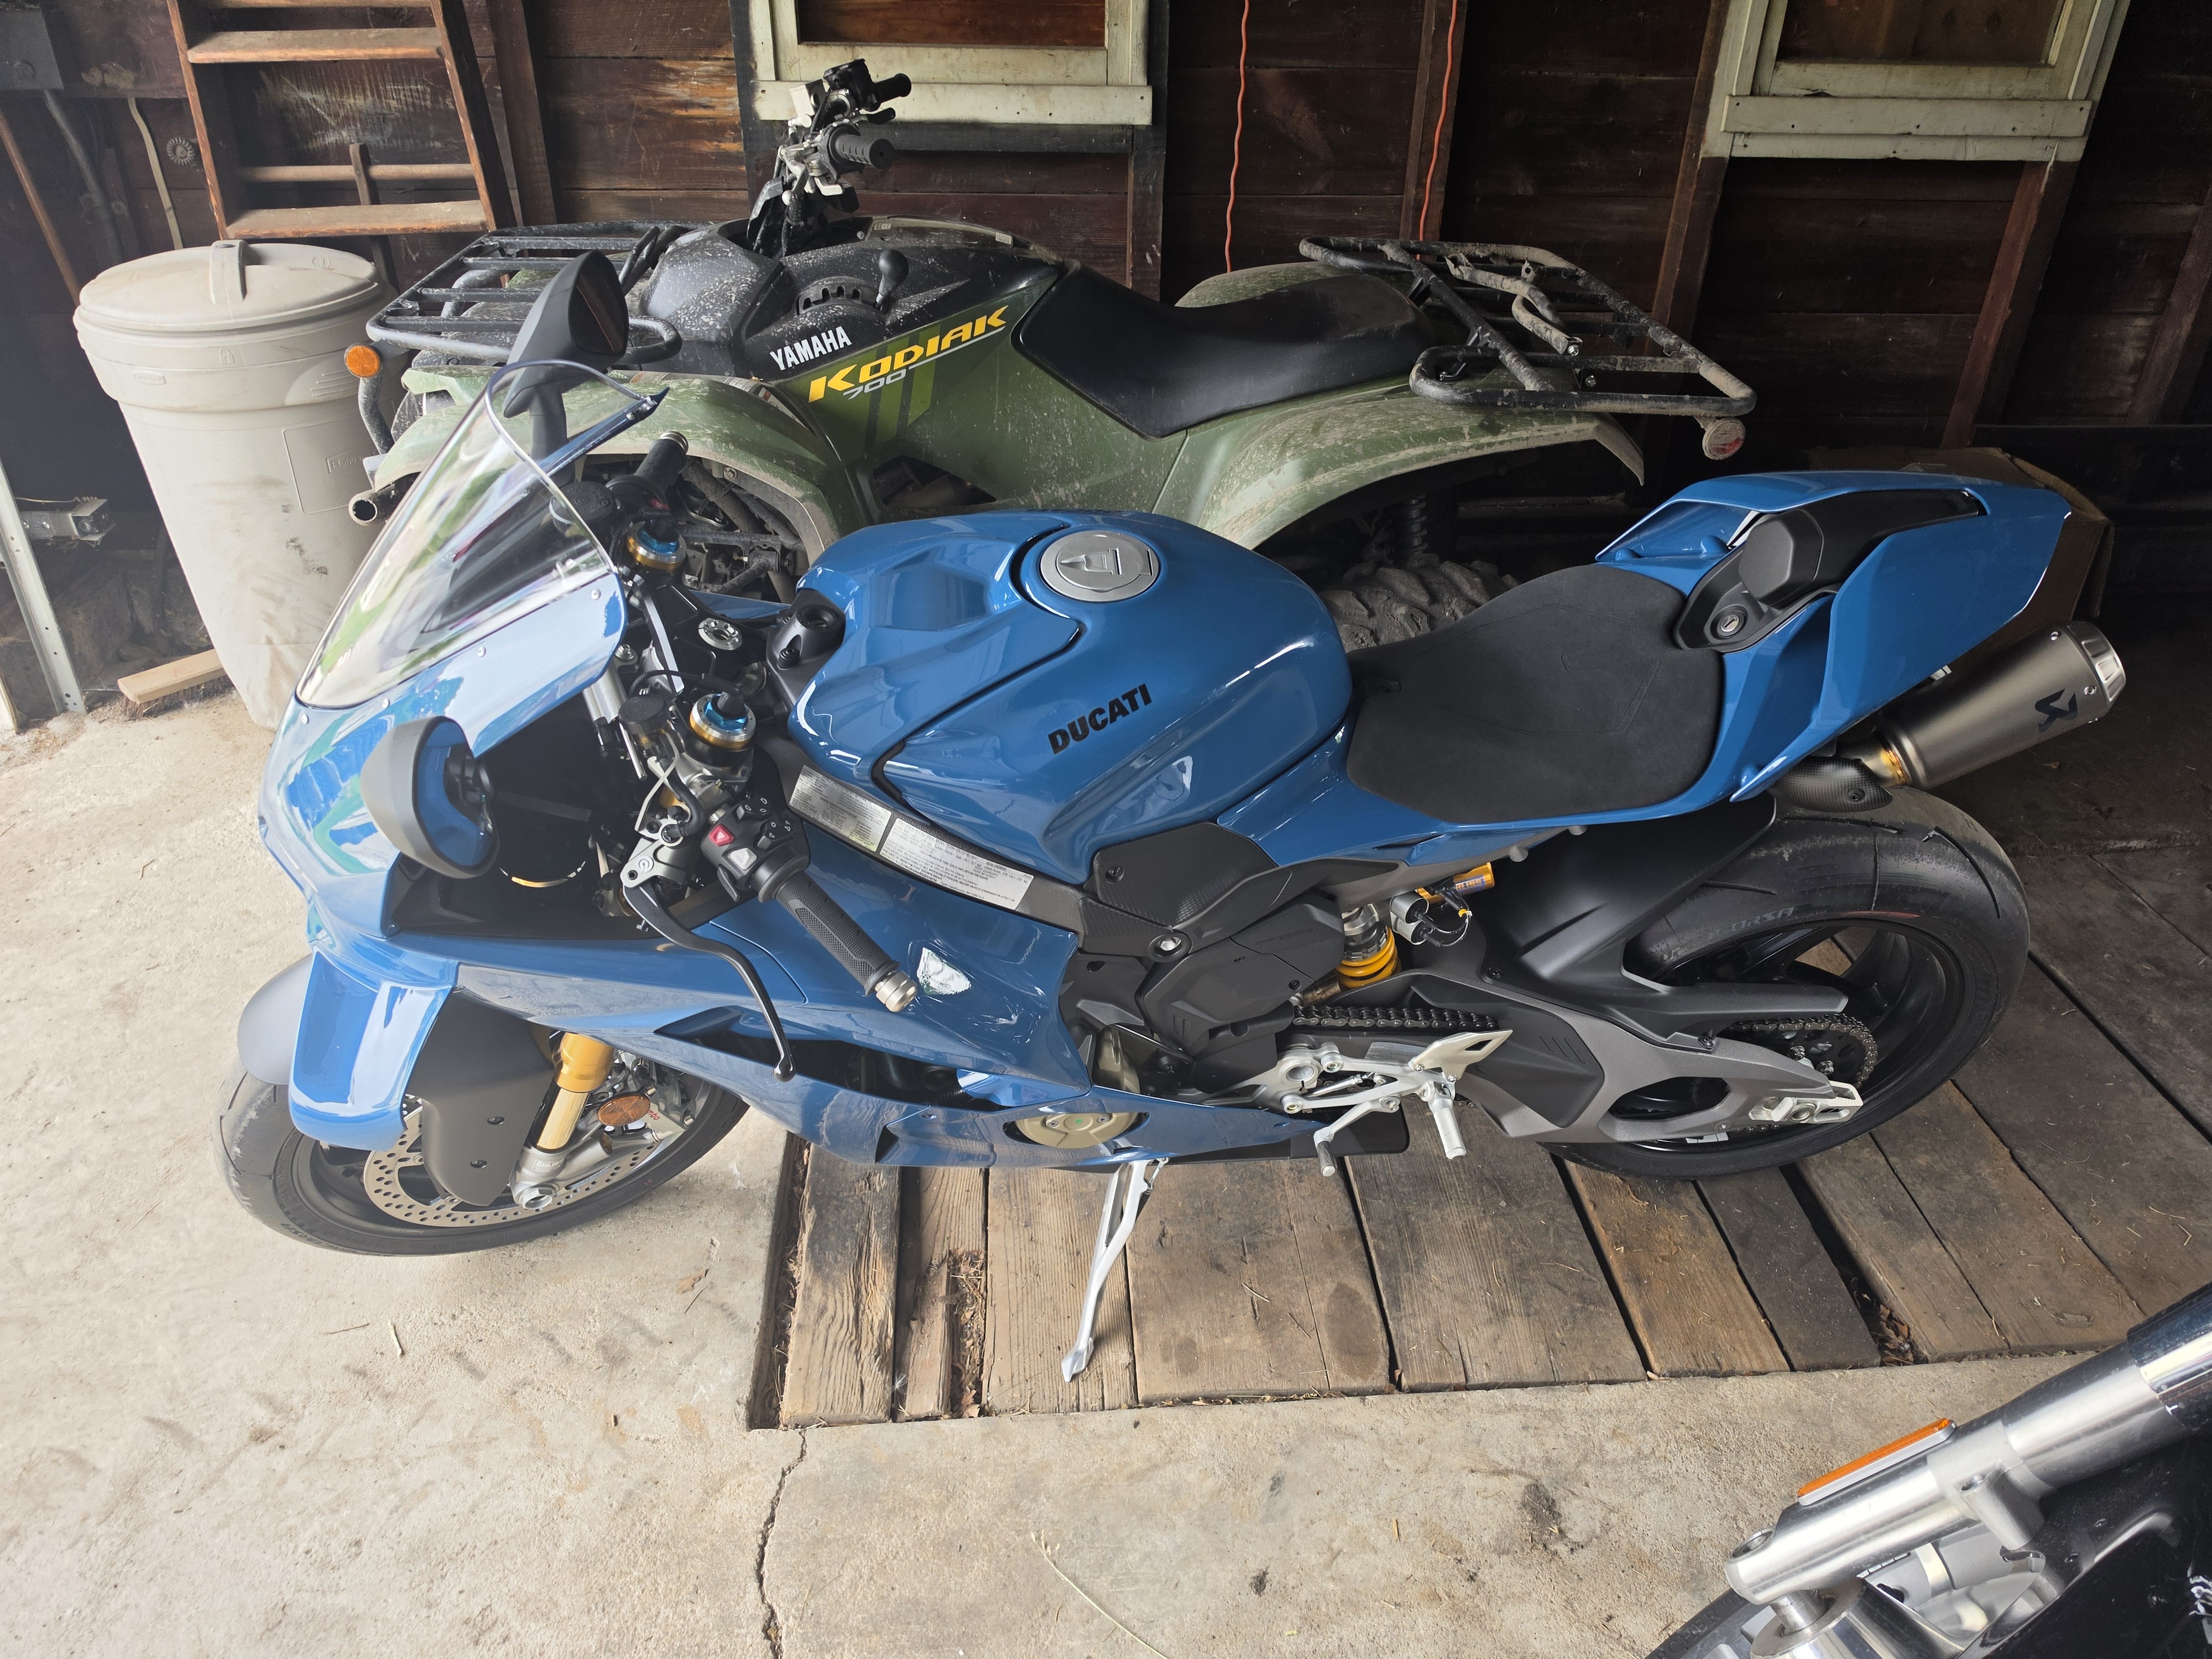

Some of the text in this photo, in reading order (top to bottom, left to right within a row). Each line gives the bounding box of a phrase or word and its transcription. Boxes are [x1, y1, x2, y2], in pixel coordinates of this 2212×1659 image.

[770, 326, 852, 370] YAMAHA
[808, 305, 1009, 403] KODIAK
[843, 369, 906, 400] 700
[1048, 684, 1151, 755] DUCATI
